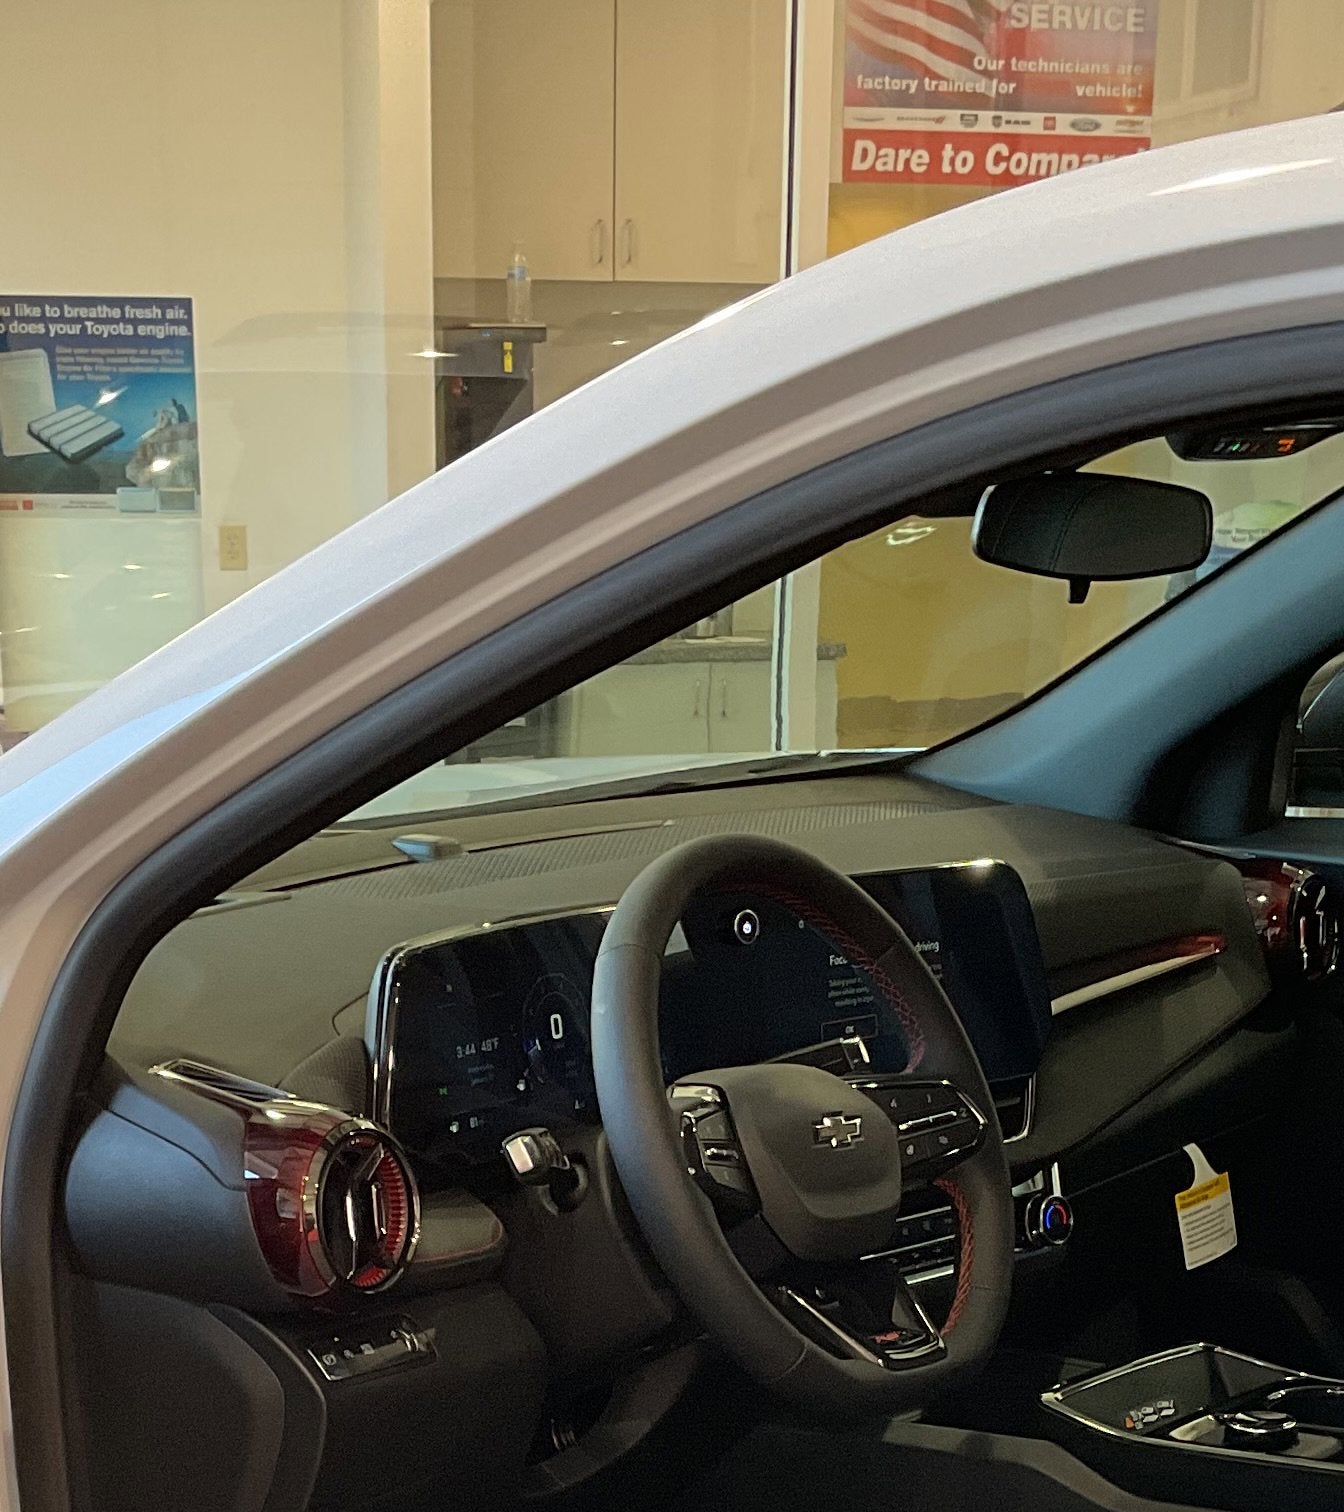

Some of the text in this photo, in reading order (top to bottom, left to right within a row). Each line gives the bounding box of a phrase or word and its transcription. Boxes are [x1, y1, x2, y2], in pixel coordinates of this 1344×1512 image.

[1009, 4, 1145, 33] SERVICE
[973, 56, 1143, 76] Our technicians are
[856, 74, 1016, 96] factory trained for
[1075, 83, 1143, 99] vehicle!
[852, 140, 930, 173] Dare
[942, 143, 974, 175] to
[15, 303, 41, 317] like
[45, 305, 60, 318] to
[64, 304, 121, 318] breathe
[124, 305, 162, 319] fresh
[166, 306, 188, 319] air.
[9, 321, 45, 334] does
[49, 323, 81, 337] your
[84, 321, 134, 338] Toyota
[137, 323, 192, 339] engine.
[550, 1014, 563, 1039] 0
